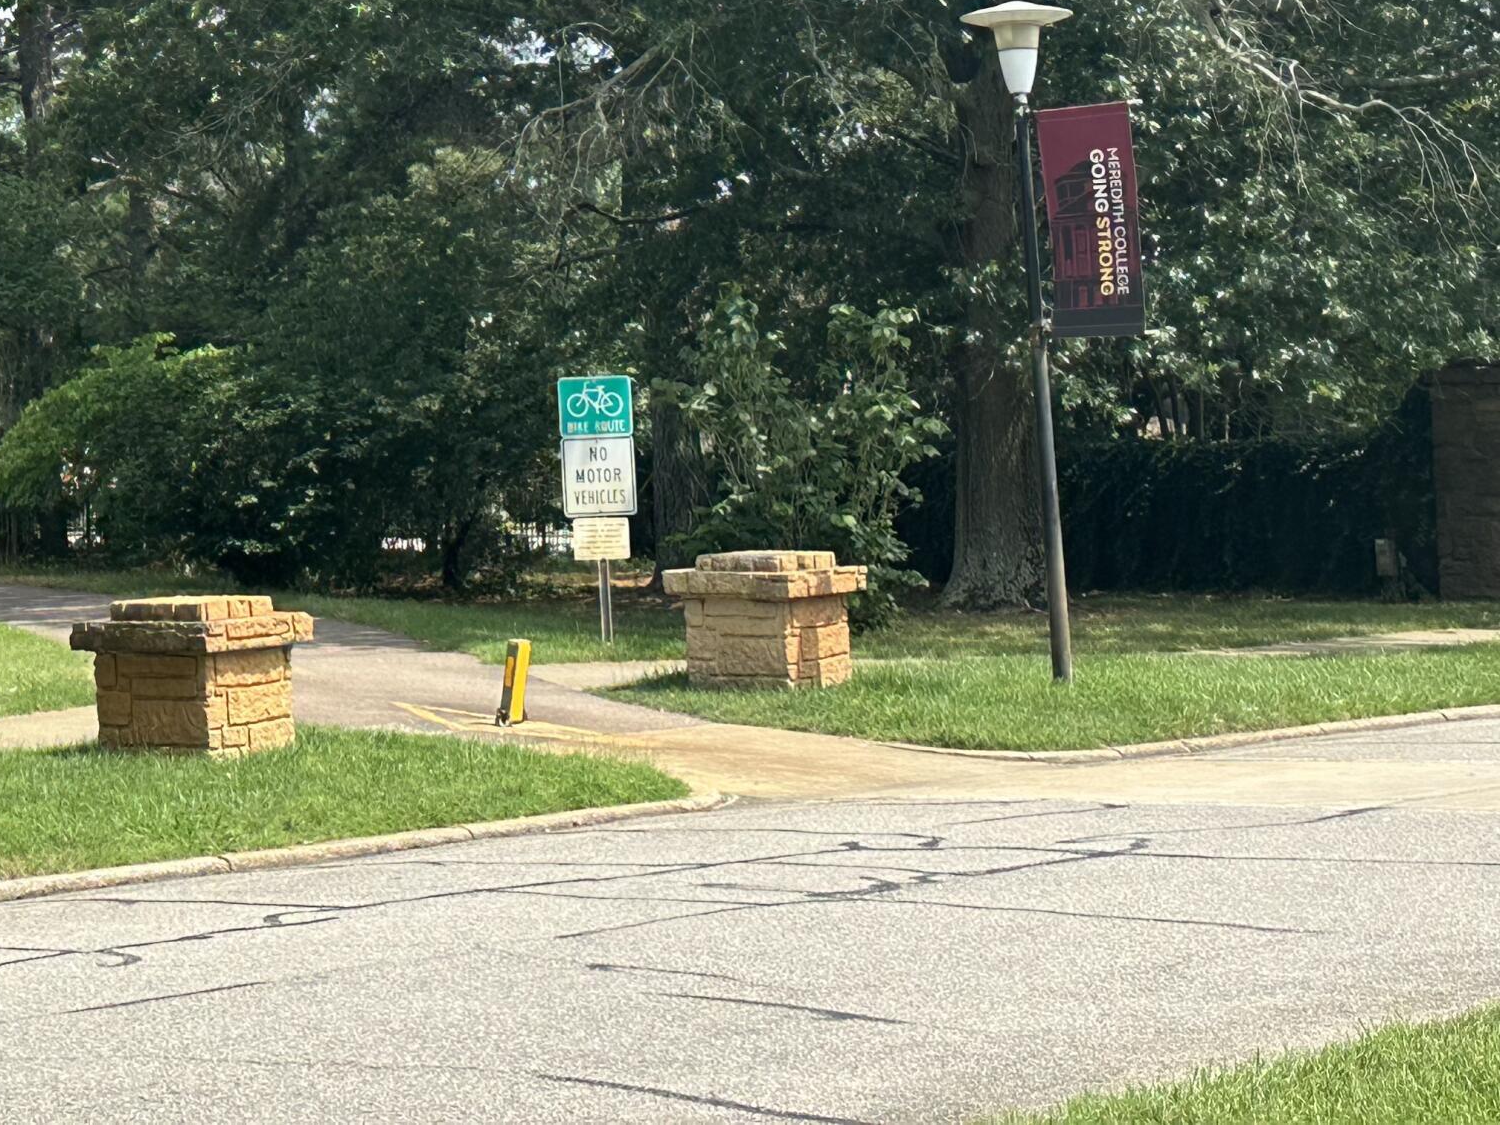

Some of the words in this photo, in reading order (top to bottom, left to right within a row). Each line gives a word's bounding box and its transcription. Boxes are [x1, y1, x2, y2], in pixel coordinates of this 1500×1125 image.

[1090, 149, 1109, 212] GOING
[1106, 147, 1125, 223] MEREDITH
[1096, 218, 1115, 296] STRONG
[1114, 227, 1129, 294] COLLEGE
[576, 468, 621, 483] MOTOR
[589, 447, 607, 462] NO
[574, 489, 626, 505] VEHICLES
